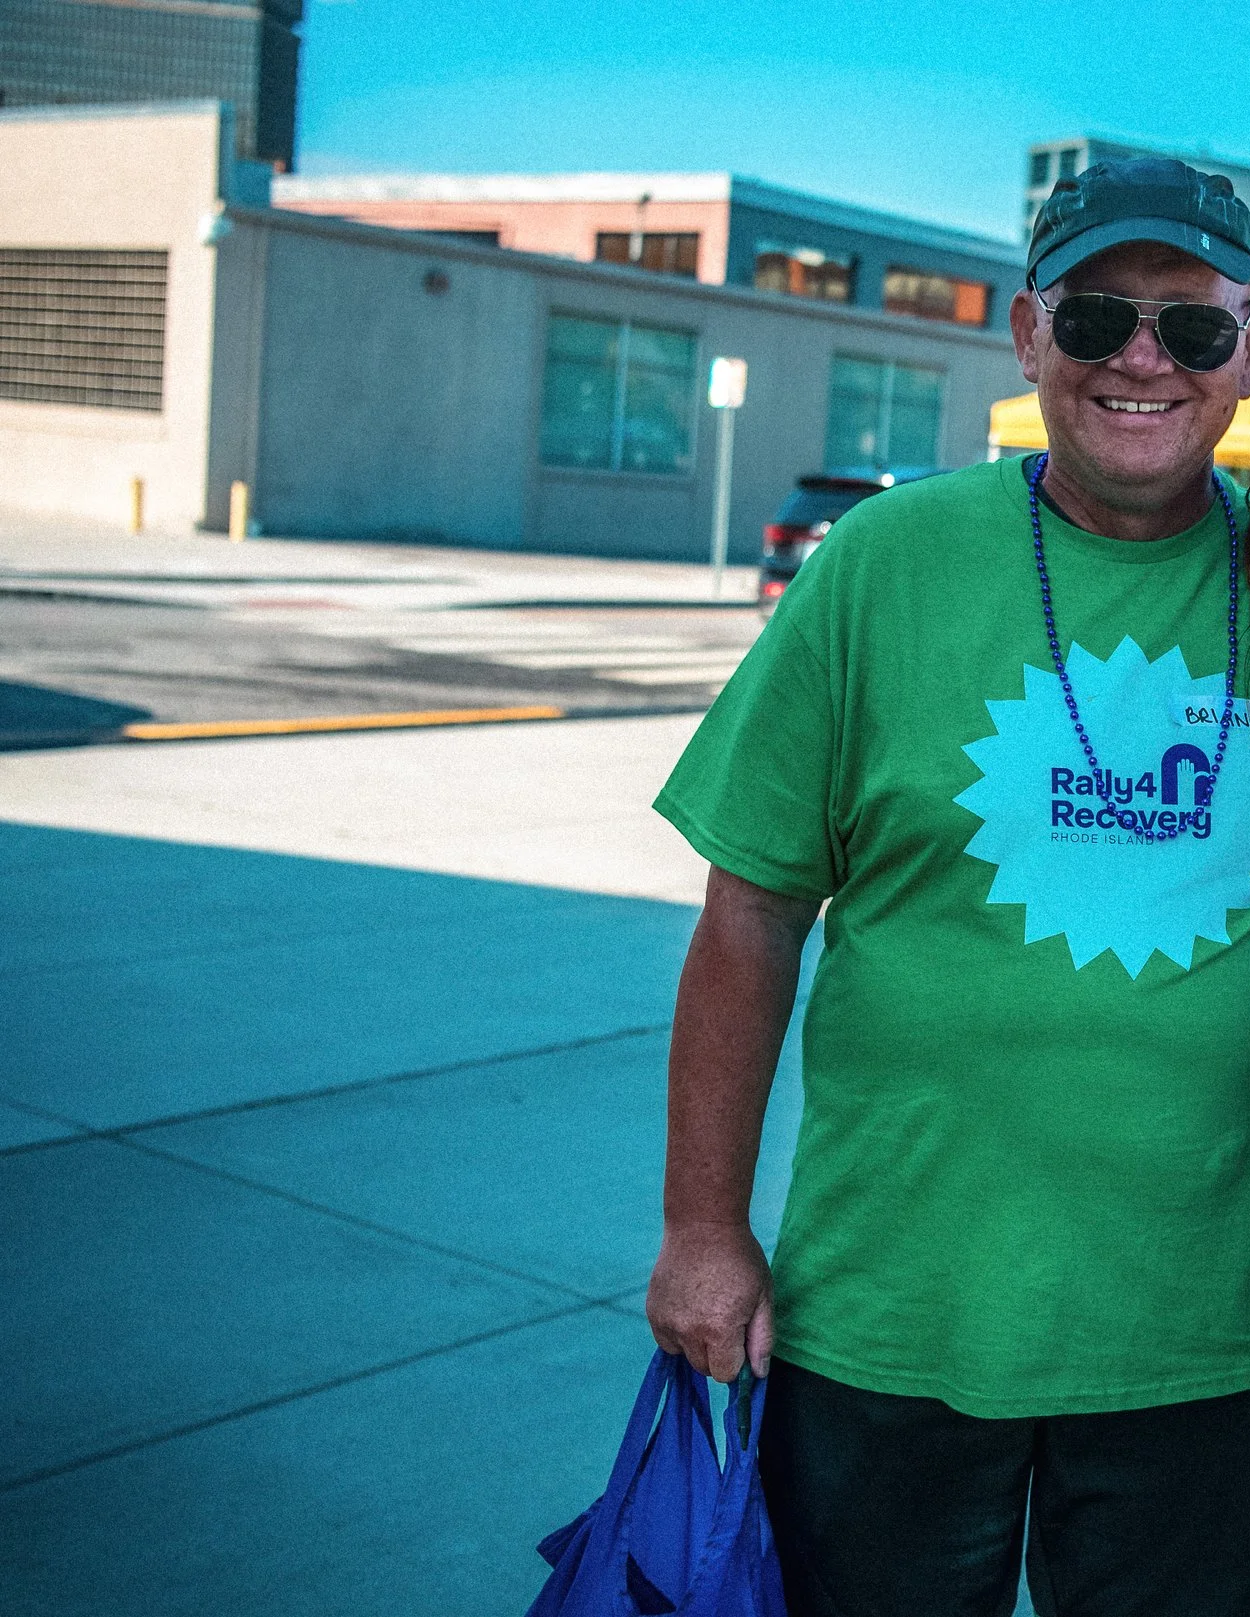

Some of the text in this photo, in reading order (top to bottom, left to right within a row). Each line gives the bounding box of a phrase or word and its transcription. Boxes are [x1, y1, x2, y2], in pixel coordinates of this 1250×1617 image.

[1185, 706, 1250, 727] BRIAN
[1051, 767, 1157, 804] Rally4
[1051, 799, 1212, 839] Recovery
[1051, 832, 1154, 846] RHODE ISLAND
